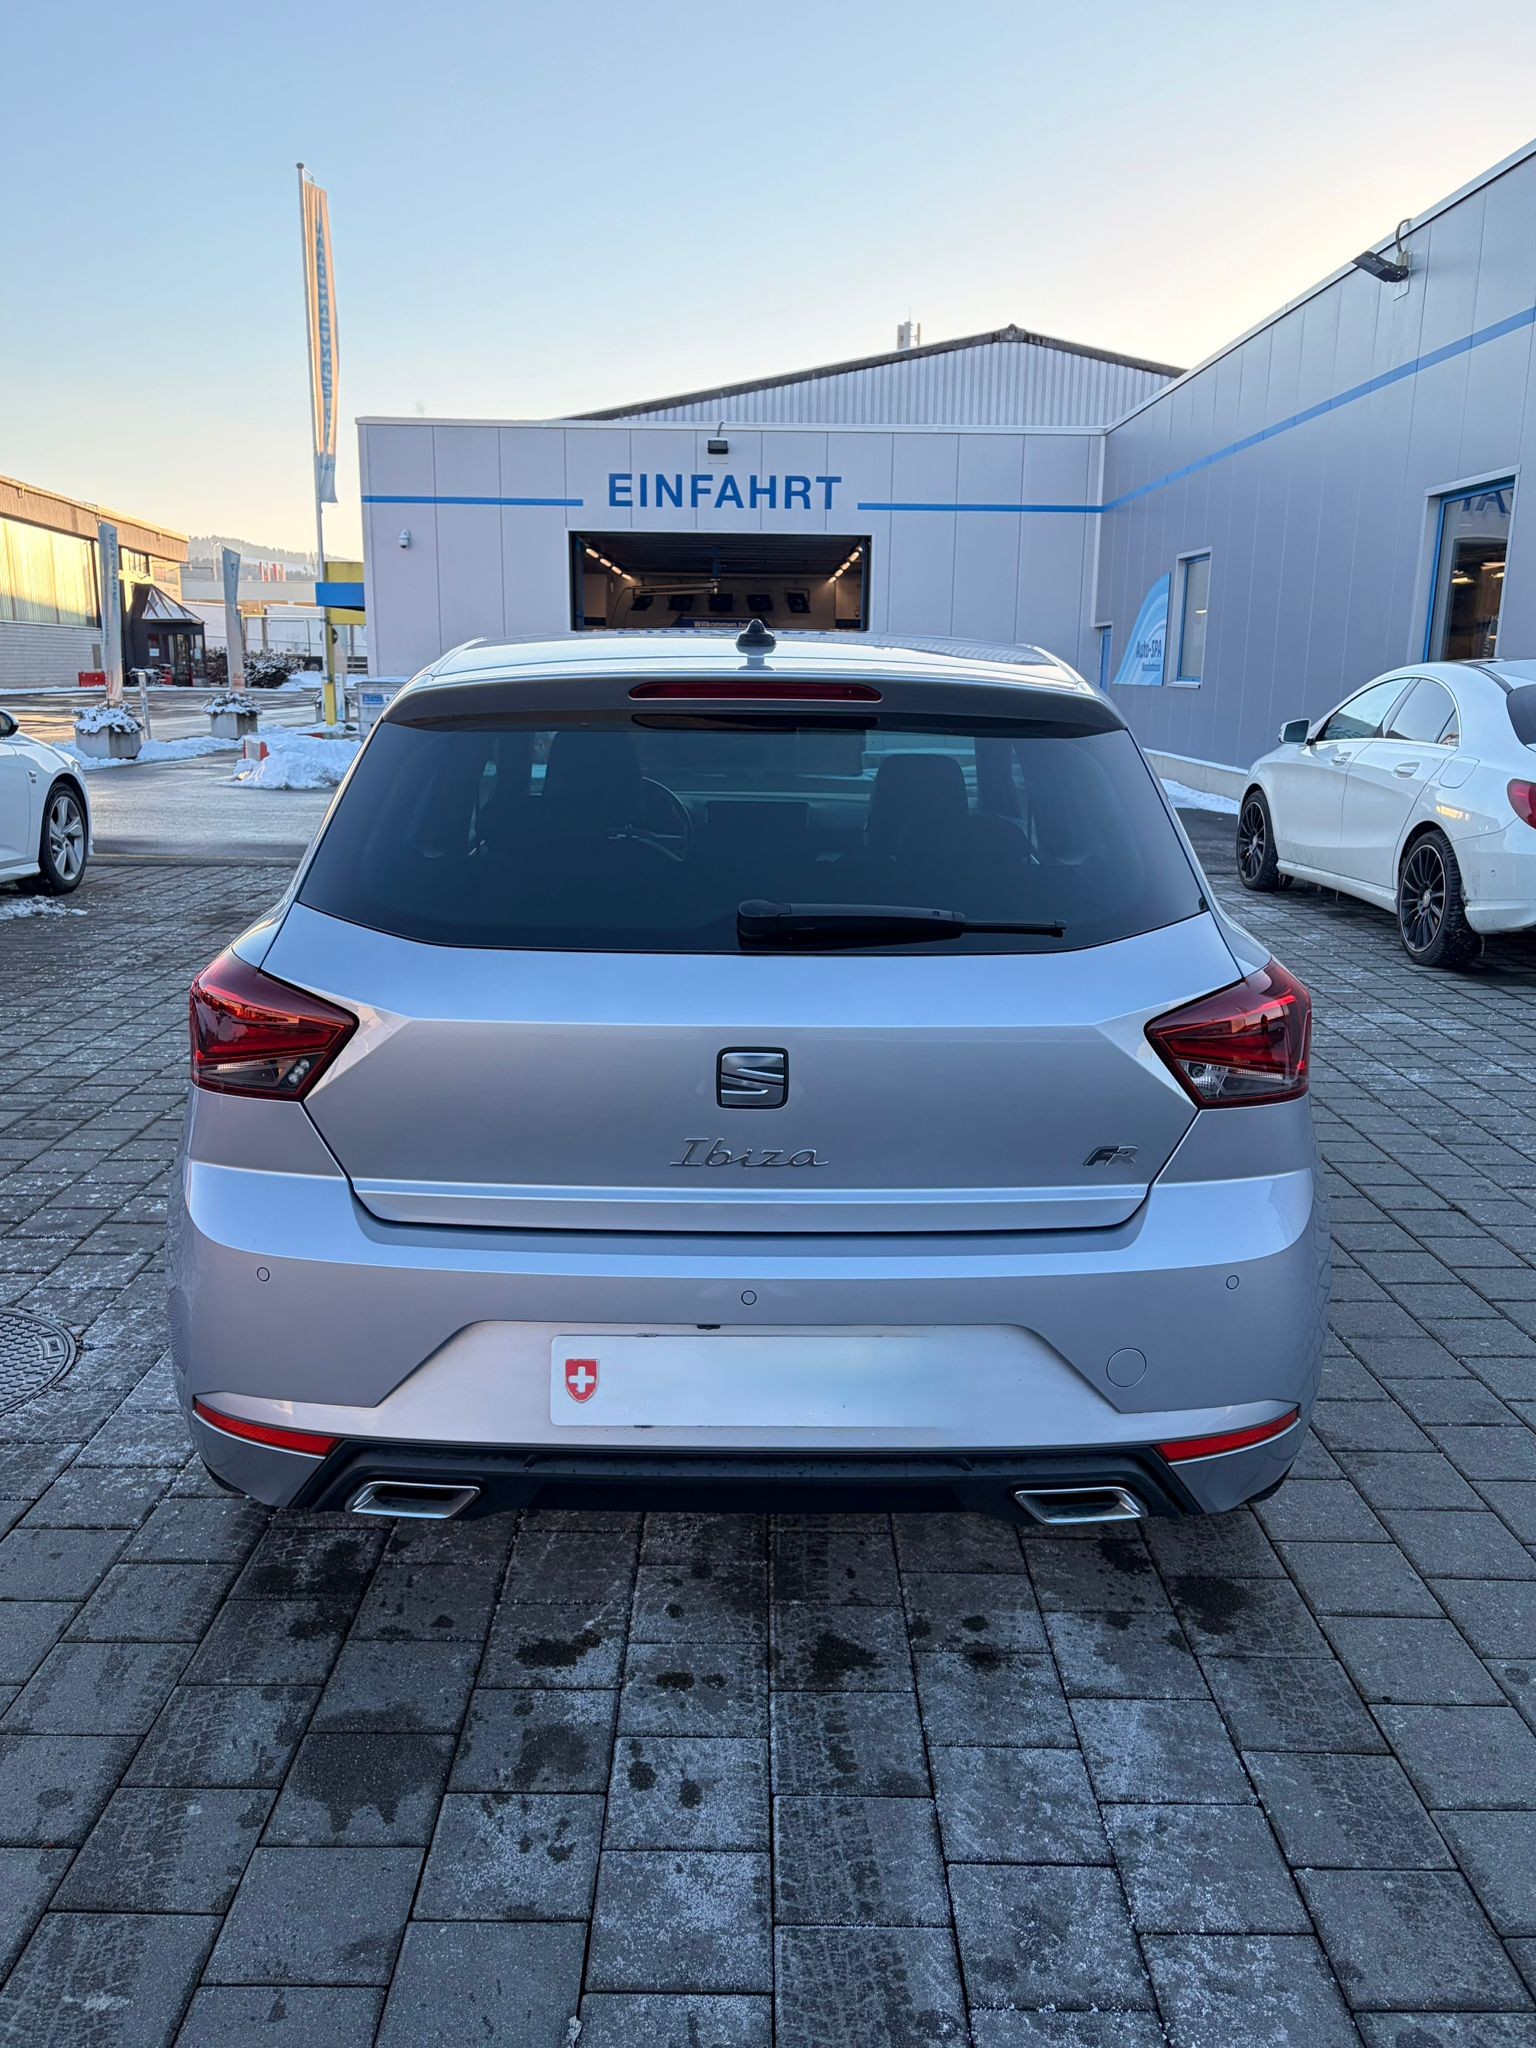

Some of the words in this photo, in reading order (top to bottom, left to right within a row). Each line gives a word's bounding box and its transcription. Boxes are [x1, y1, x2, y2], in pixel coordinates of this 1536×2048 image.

[608, 473, 842, 510] EINFAHRT
[1135, 639, 1162, 659] Auto-SPA
[669, 1137, 829, 1168] Ibiza
[1083, 1145, 1138, 1167] FR
